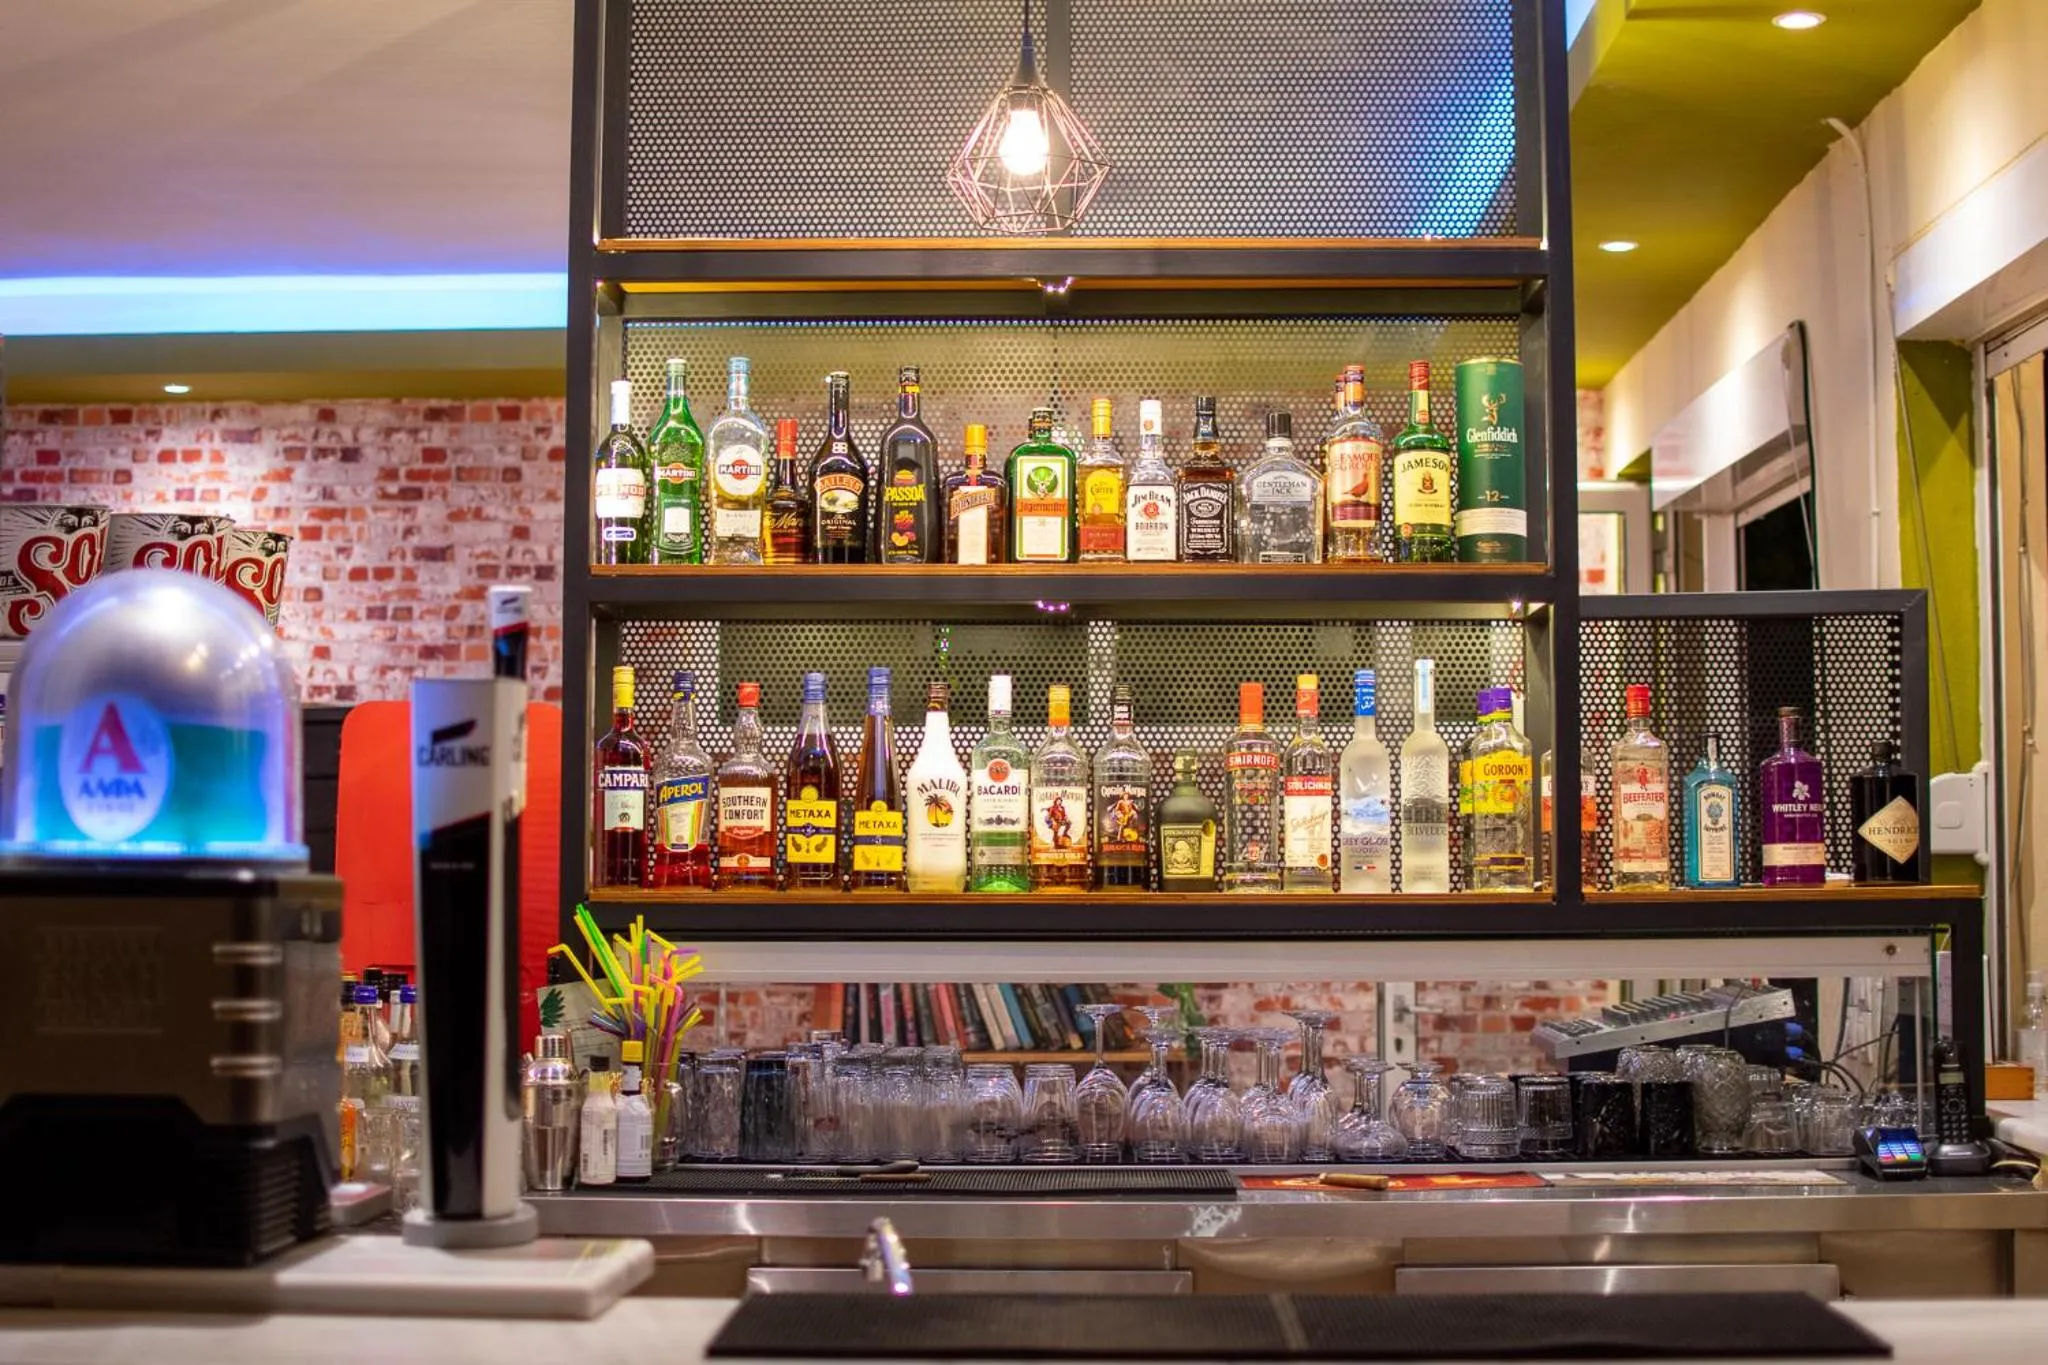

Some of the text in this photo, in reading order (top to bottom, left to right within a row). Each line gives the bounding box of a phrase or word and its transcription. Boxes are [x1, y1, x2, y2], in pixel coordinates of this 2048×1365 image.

[1466, 426, 1518, 443] Glenfiddich
[720, 465, 761, 475] MARTINI
[1401, 457, 1449, 473] JAMESON
[815, 474, 862, 491] BAILEYS
[1485, 490, 1499, 502] 12
[1229, 754, 1275, 767] SMIRNOFF
[599, 773, 649, 788] CAMPARI
[659, 782, 705, 802] APEROL
[1623, 792, 1665, 804] BEEFEATER
[722, 795, 768, 808] SOUTHERN
[1772, 803, 1809, 813] WHITLEY
[724, 808, 765, 821] COMFORT
[789, 808, 831, 820] METAXA
[858, 819, 898, 830] METAXA
